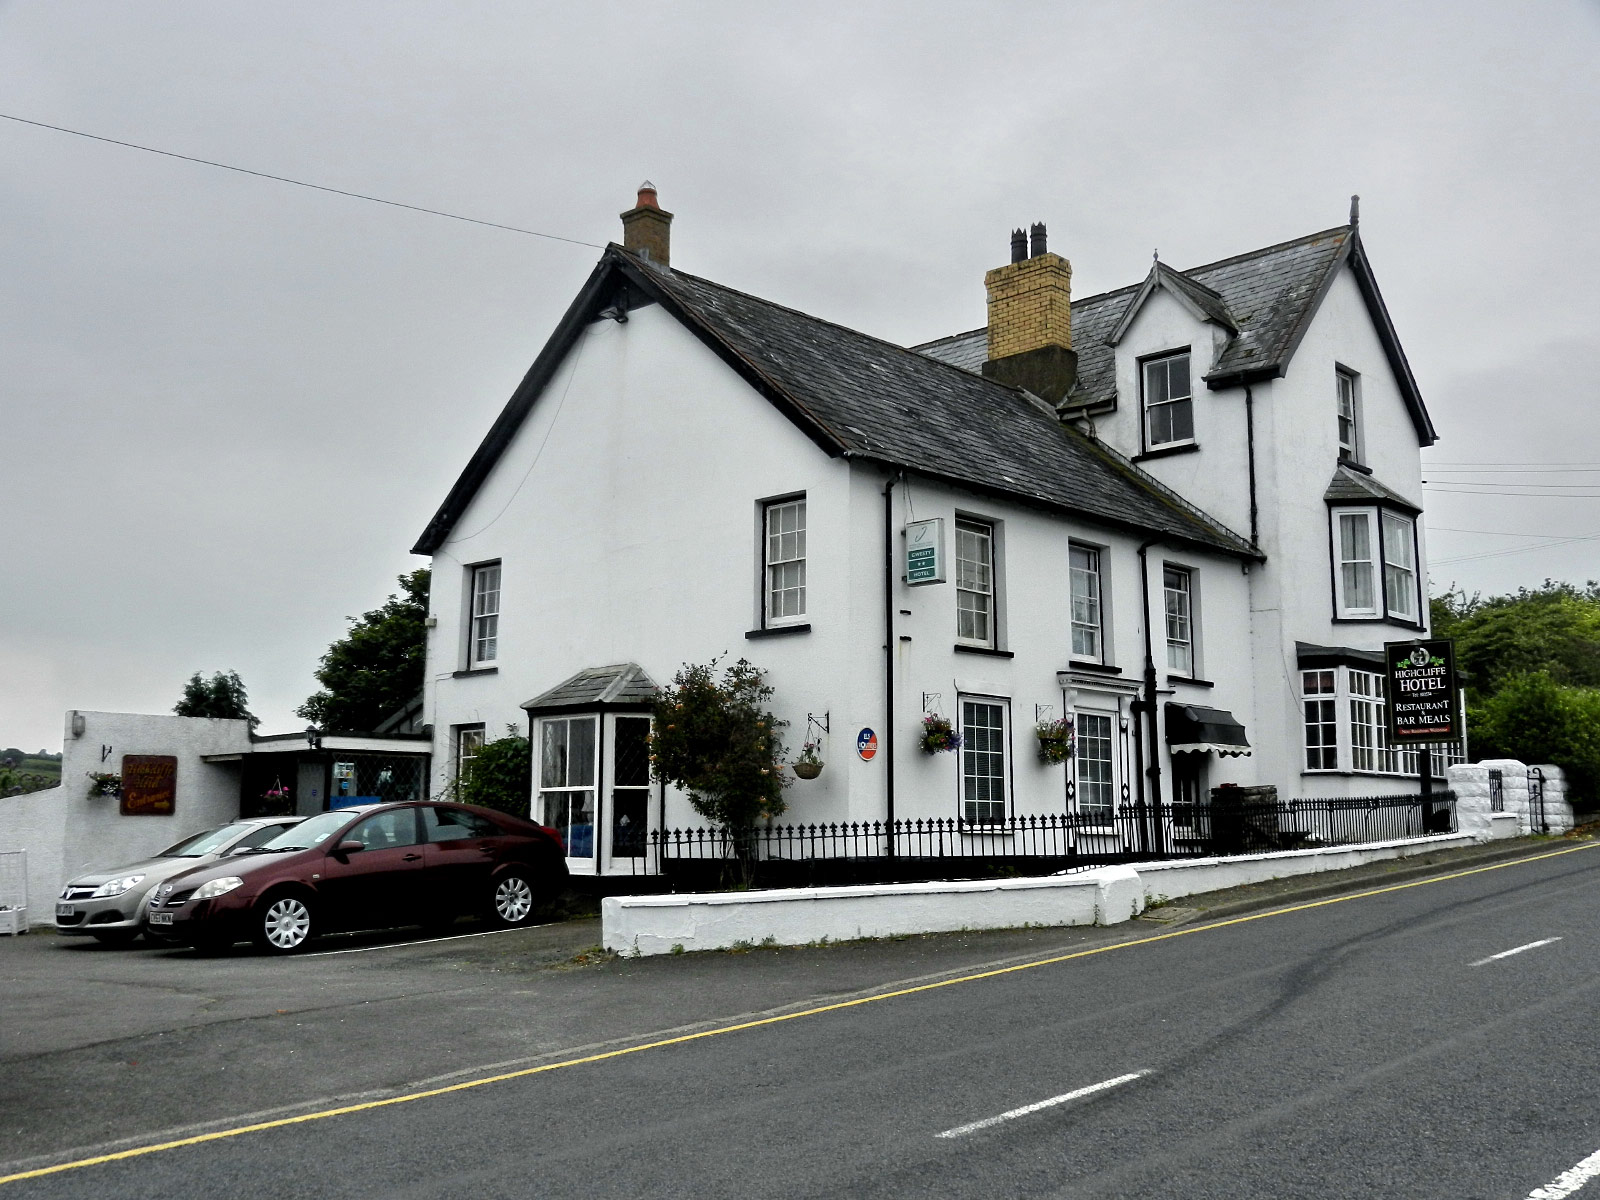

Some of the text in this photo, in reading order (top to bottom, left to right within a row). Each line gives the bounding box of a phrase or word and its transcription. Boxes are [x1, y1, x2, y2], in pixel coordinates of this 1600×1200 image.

[1395, 667, 1446, 678] HIGHCLIFFE
[1400, 678, 1446, 691] HOTEL
[1396, 700, 1449, 711] RESTAURANT
[1397, 715, 1450, 725] BAR MEALS
